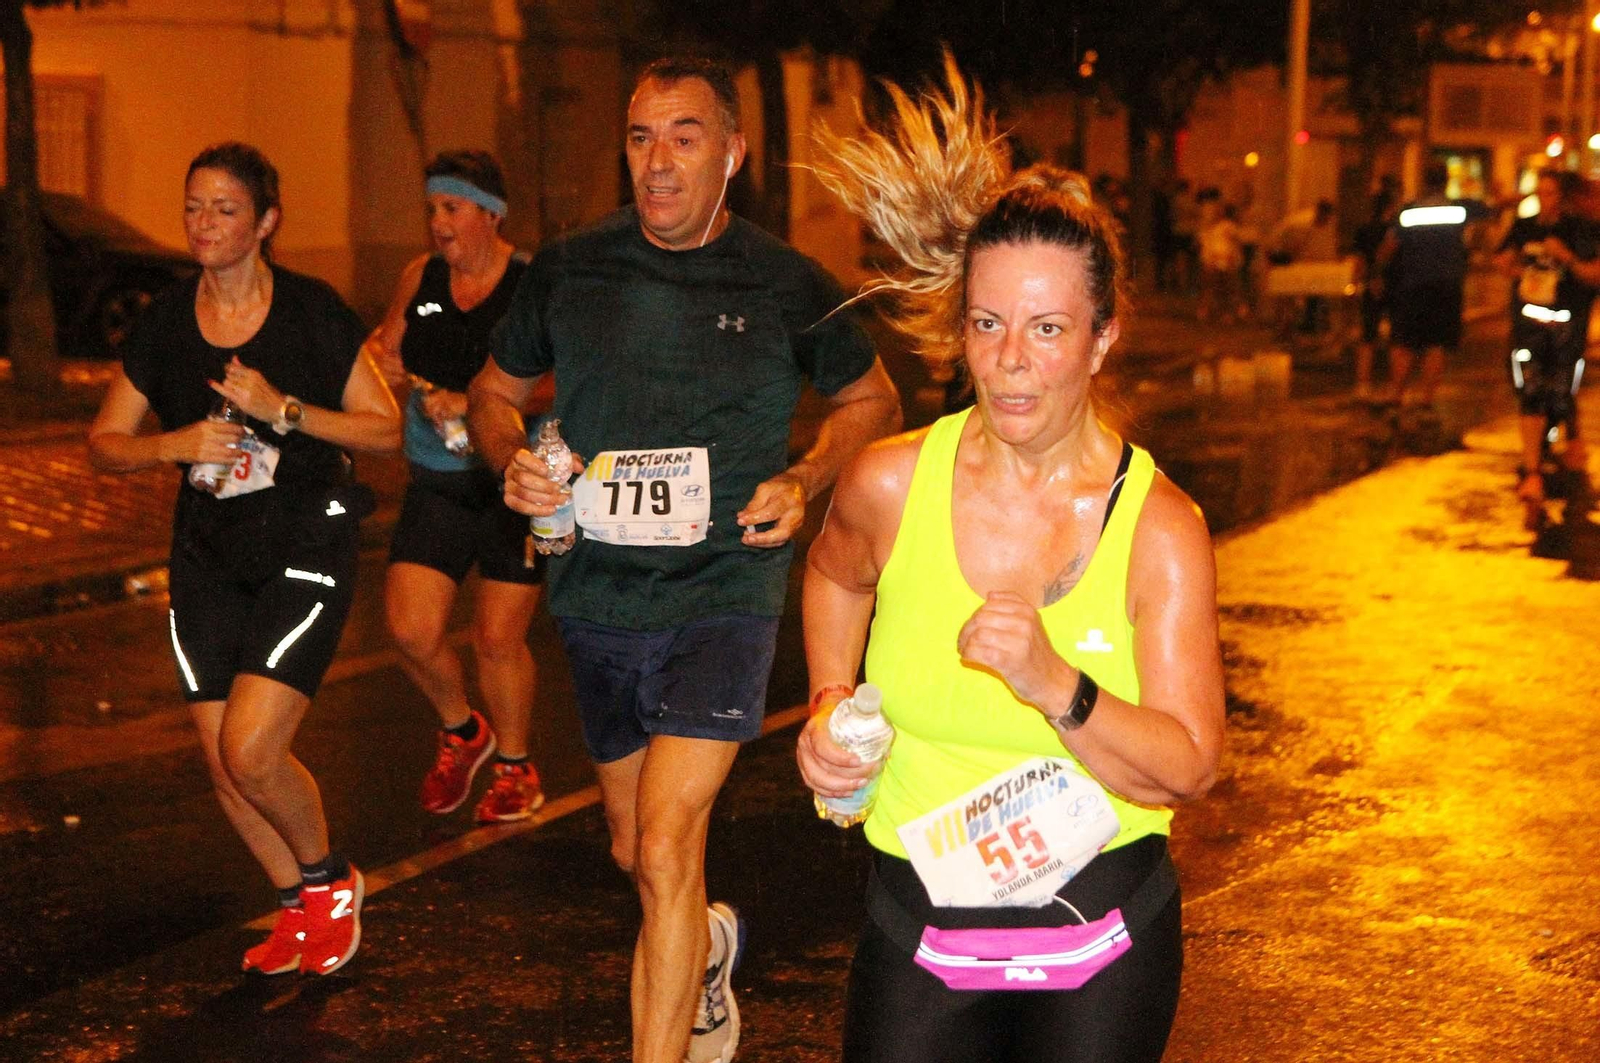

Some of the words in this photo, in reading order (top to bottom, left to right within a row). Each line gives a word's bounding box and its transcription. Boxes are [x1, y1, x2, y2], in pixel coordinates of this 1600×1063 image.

[612, 467, 632, 481] DE
[636, 465, 691, 480] HUELVA
[615, 452, 692, 468] NOCTURNA
[602, 480, 672, 516] 779
[925, 807, 967, 859] VII
[965, 761, 1062, 824] NOCTURNA
[967, 812, 993, 844] DE
[975, 815, 1050, 885] 55
[991, 873, 1033, 901] YOLANDA
[1033, 858, 1064, 880] MARIA
[1005, 967, 1048, 982] FILA
